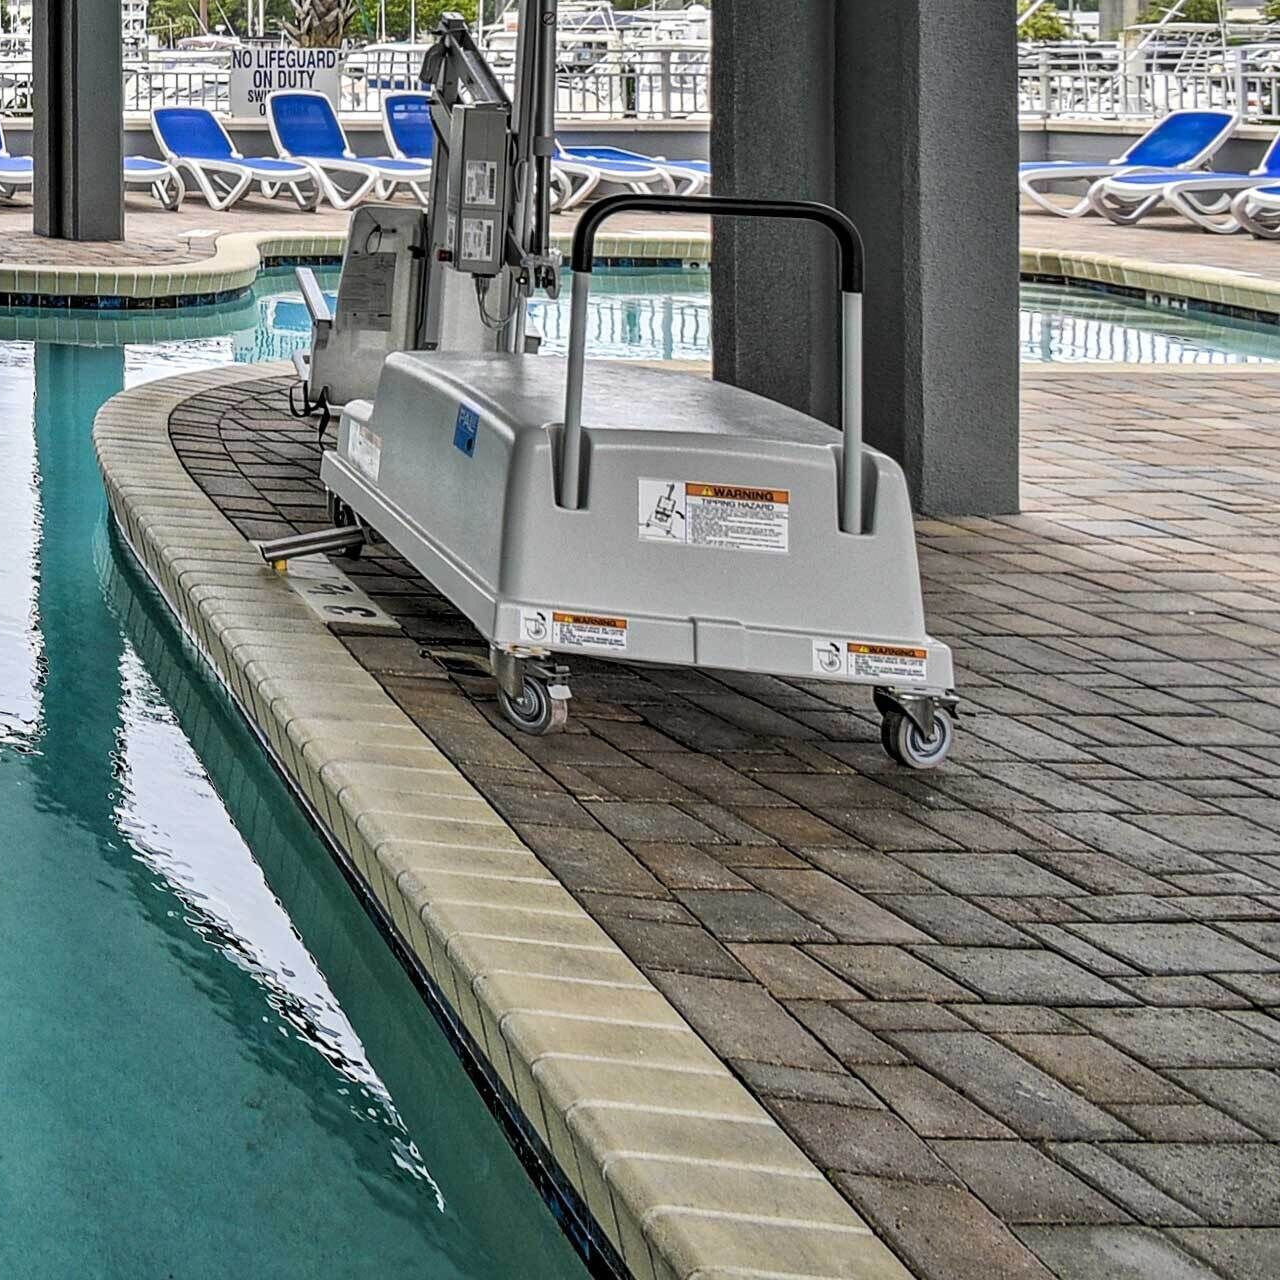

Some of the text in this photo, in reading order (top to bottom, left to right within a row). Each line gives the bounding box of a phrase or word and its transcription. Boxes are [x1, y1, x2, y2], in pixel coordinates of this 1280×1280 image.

[232, 50, 336, 69] NO LIFEGUARD
[253, 70, 315, 88] ON DUTY
[713, 487, 775, 502] WARNING
[701, 498, 775, 512] TIPPING HAZARD
[323, 605, 378, 618] 3
